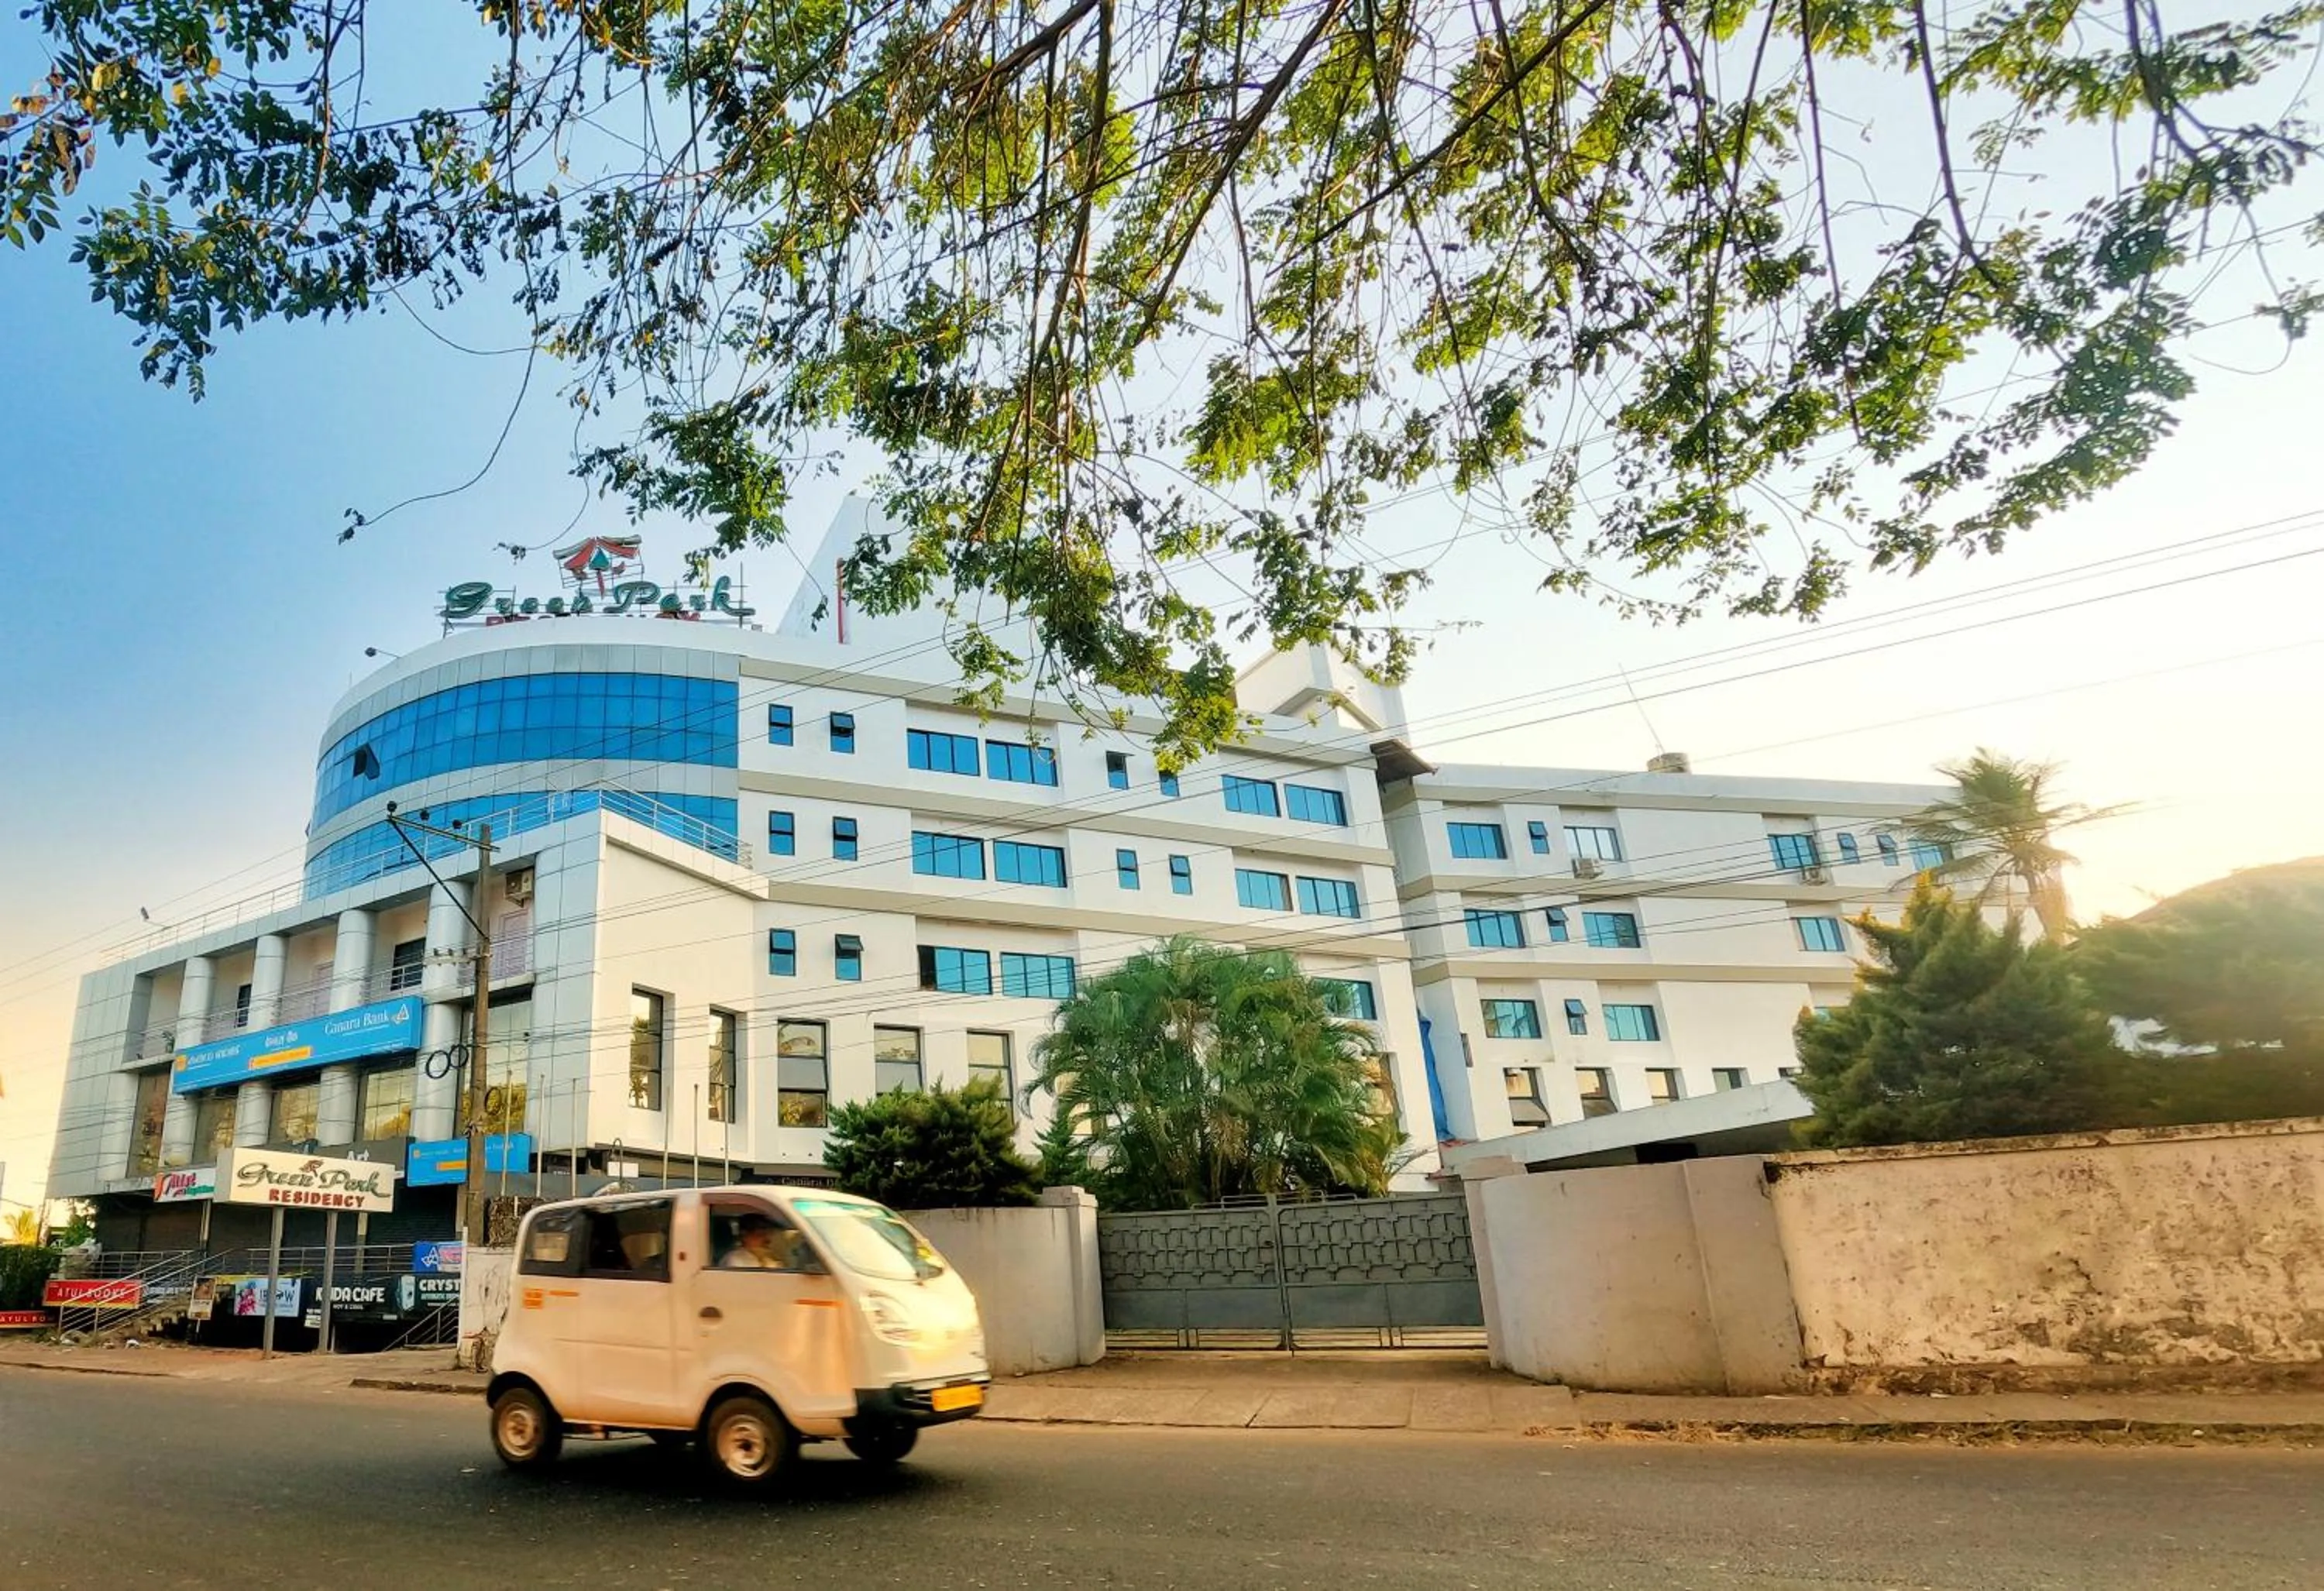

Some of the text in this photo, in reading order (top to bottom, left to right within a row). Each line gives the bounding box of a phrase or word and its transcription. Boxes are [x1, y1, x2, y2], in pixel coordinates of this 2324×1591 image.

[436, 582, 594, 618] Green
[603, 576, 756, 617] Park
[324, 1009, 390, 1035] Canara Bank
[236, 1162, 391, 1198] Green Park
[269, 1188, 365, 1208] RESIDENCY
[352, 1287, 385, 1303] CAFE
